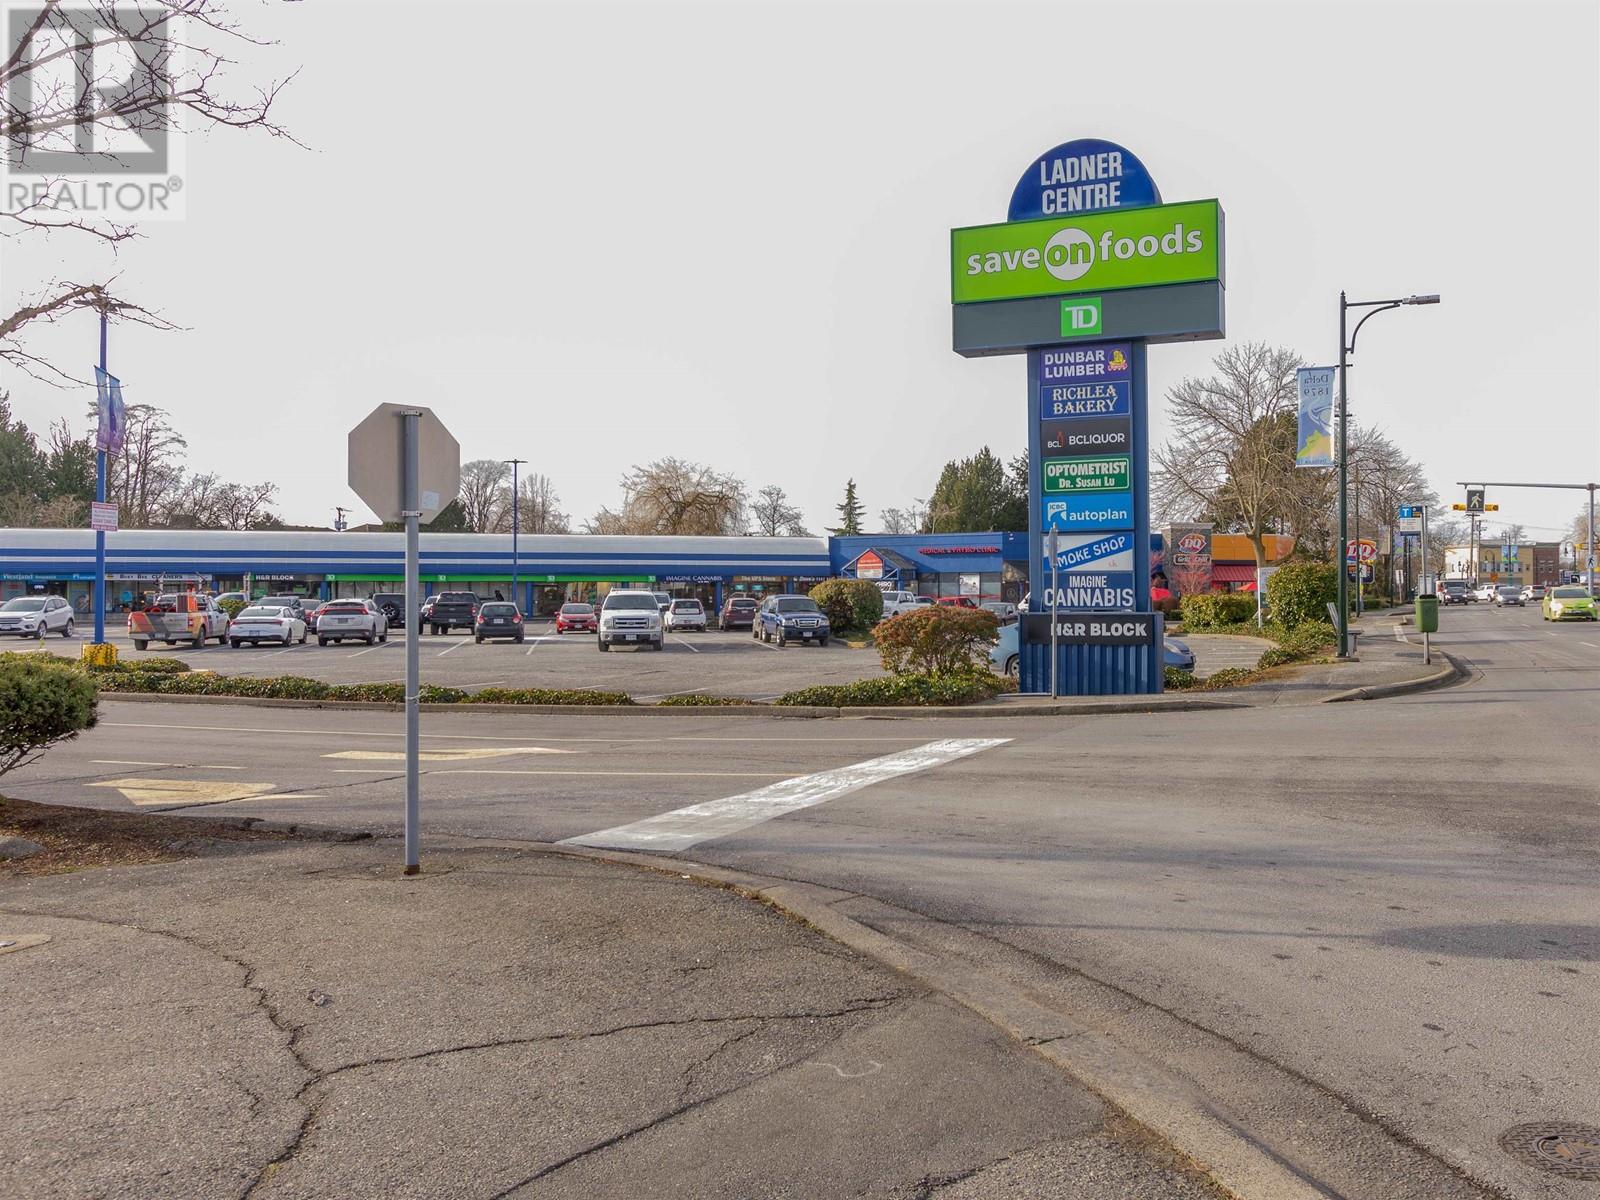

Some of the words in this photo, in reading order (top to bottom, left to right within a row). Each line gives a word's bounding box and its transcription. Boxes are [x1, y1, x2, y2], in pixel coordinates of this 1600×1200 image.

[1040, 151, 1123, 186] LADNER
[1042, 181, 1121, 215] CENTRE
[967, 245, 1040, 276] save
[1046, 239, 1091, 267] on
[1098, 223, 1203, 262] foods
[1065, 304, 1098, 329] TD
[1044, 350, 1105, 365] DUNBAR
[1045, 363, 1105, 379] LUMBER
[1053, 384, 1118, 401] RICHLEA
[1053, 396, 1118, 415] BAKERY
[1047, 461, 1127, 477] OPTOMETRIST
[1069, 508, 1127, 522] autoplan
[1055, 548, 1091, 568] MOKE
[1093, 537, 1125, 556] SHOP
[1069, 575, 1108, 588] IMAGINE
[1044, 588, 1134, 607] CANNABIS
[1051, 623, 1086, 637] H&R
[1090, 623, 1148, 637] BLOCK
